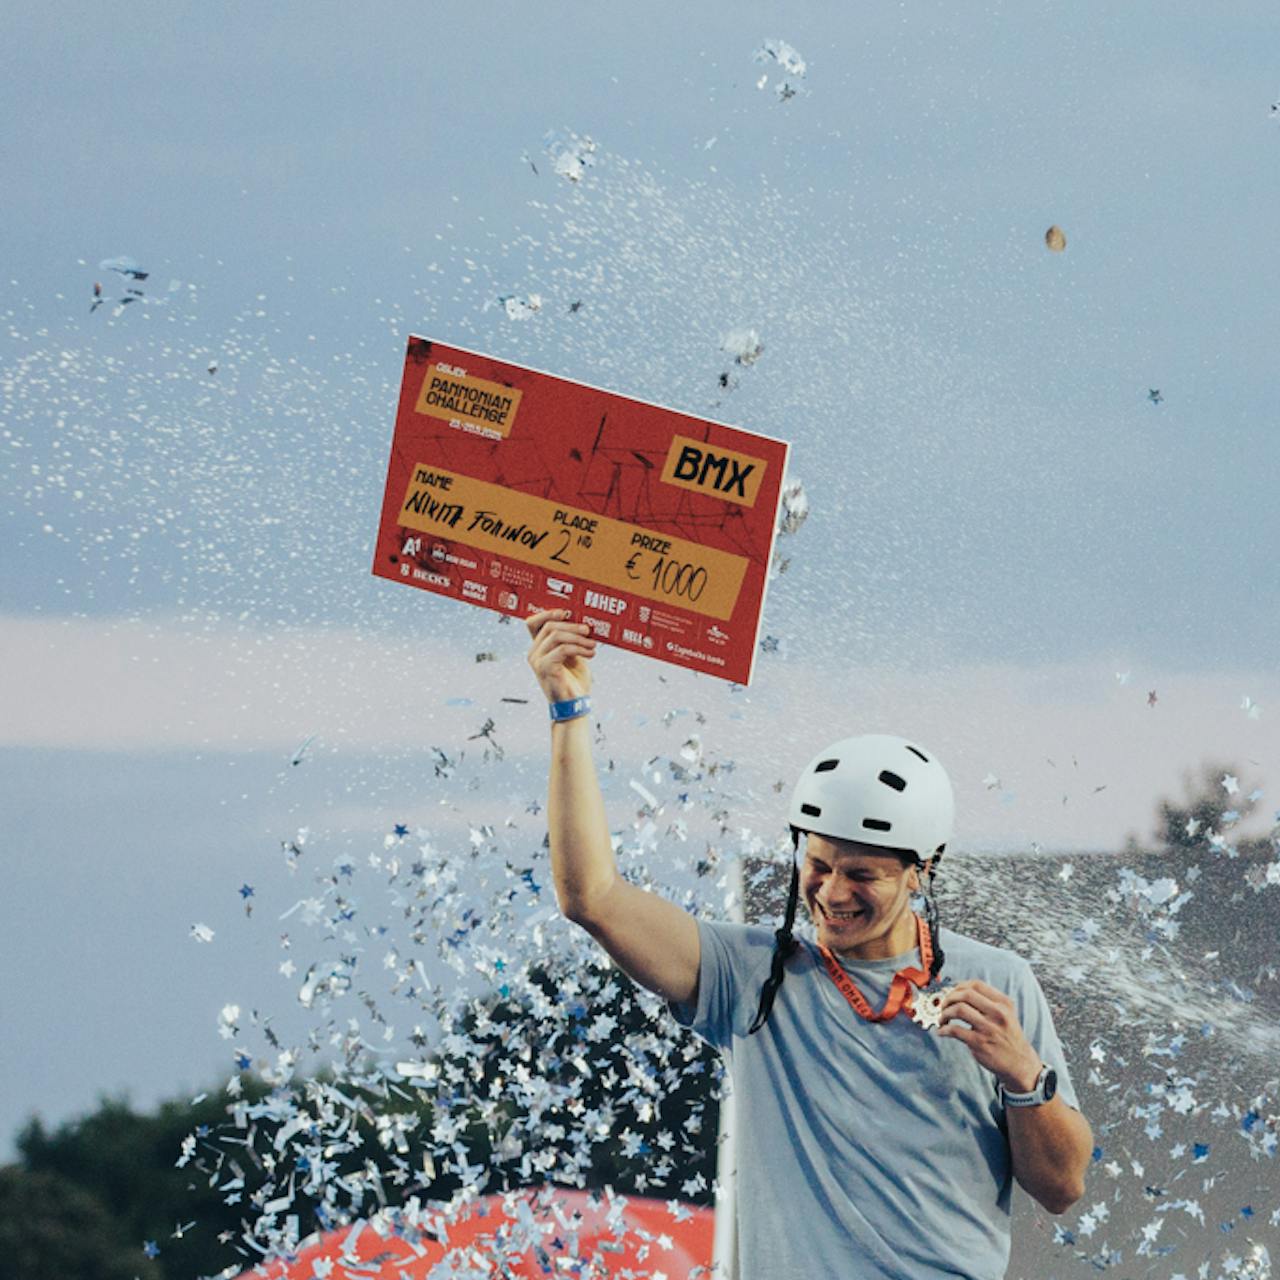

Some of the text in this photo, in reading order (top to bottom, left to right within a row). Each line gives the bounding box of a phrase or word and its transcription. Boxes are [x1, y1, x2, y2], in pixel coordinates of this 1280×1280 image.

[430, 376, 513, 411] PANNONIAN
[426, 391, 508, 426] CHALLENGE
[415, 469, 454, 491] NAME
[673, 445, 755, 498] BMX
[553, 509, 599, 534] PLACE
[401, 536, 421, 557] A1
[630, 532, 672, 556] PRIZE
[652, 556, 708, 602] 1000
[599, 592, 628, 616] HEP
